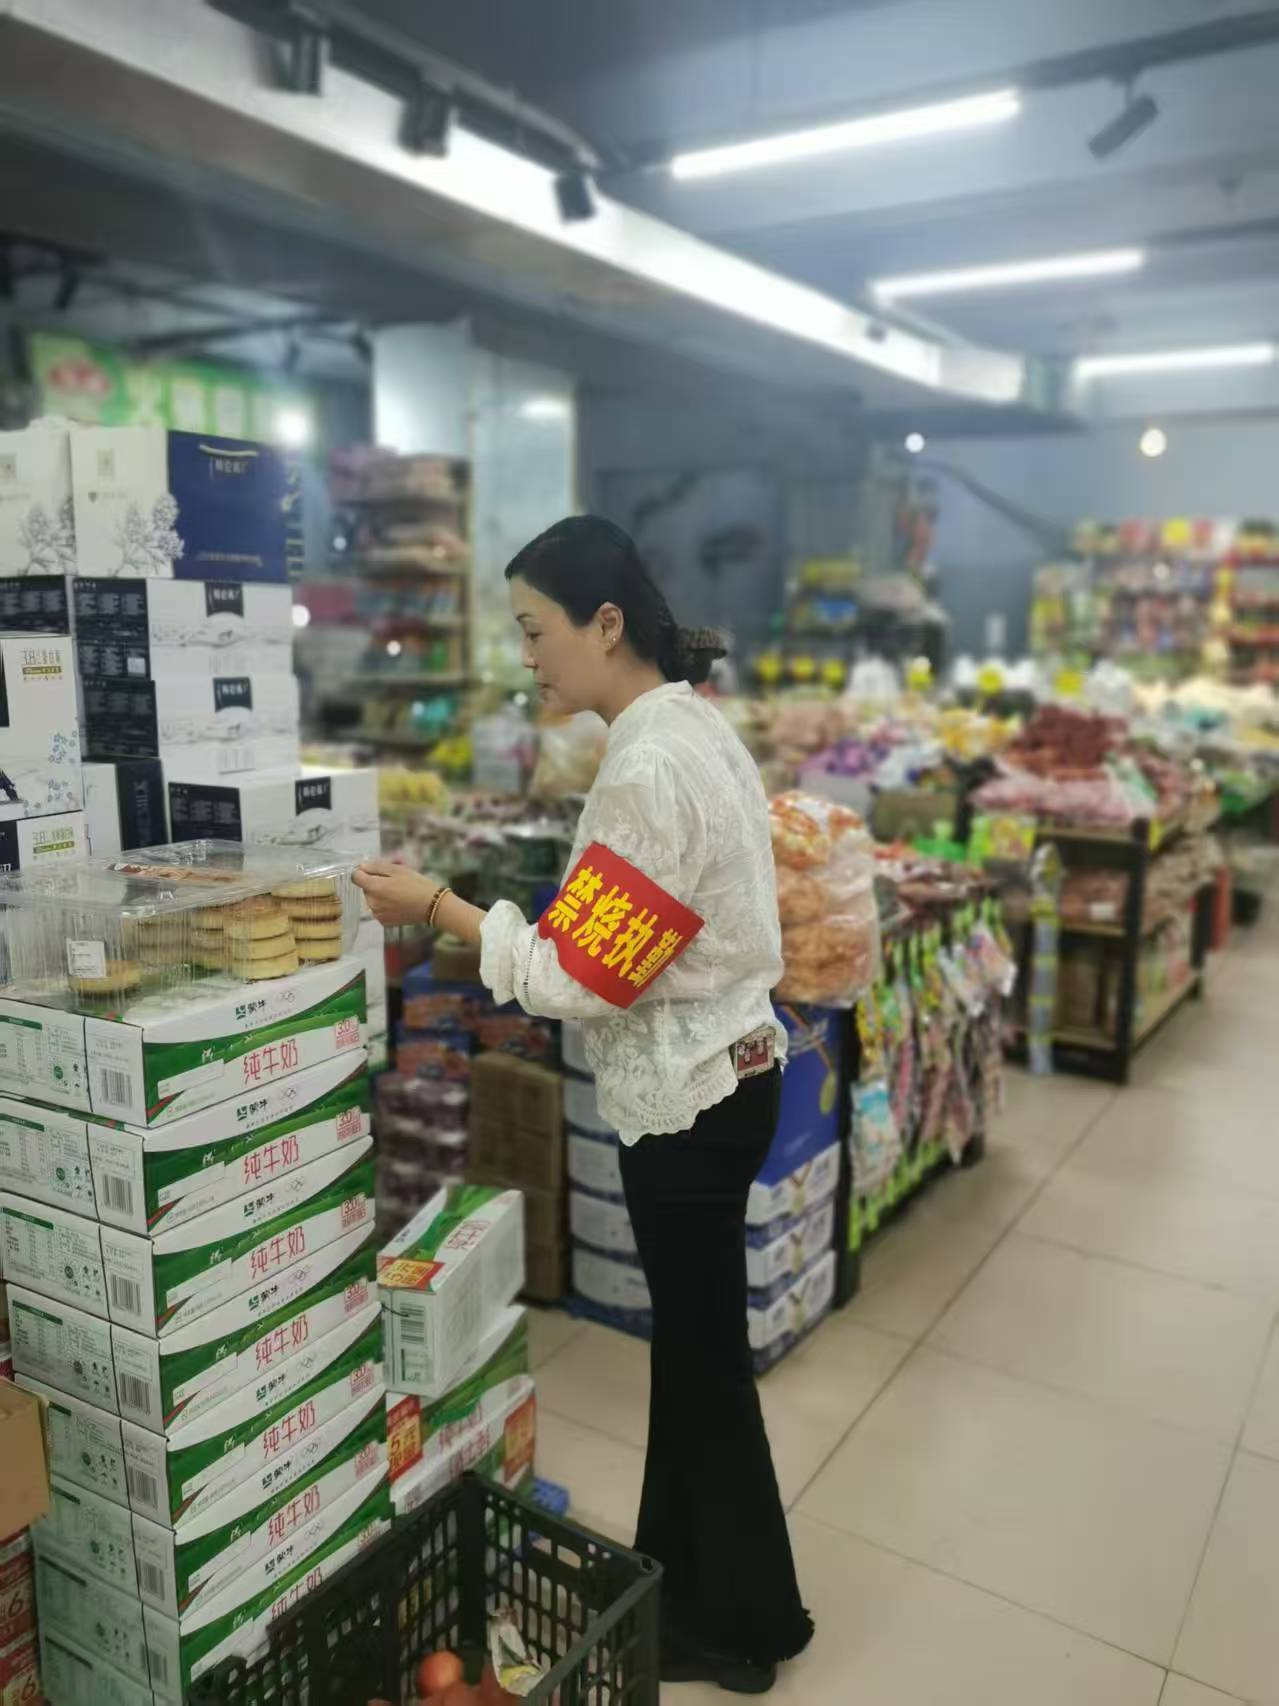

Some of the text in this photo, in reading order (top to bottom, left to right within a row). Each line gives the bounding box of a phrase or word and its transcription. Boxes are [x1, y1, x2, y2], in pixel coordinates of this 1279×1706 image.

[547, 865, 683, 988] 禁烧执勤
[243, 1038, 299, 1085] 纯牛奶
[244, 1135, 299, 1184] 纯牛奶
[250, 1225, 305, 1279] 纯牛奶
[256, 1314, 308, 1371] 纯牛奶
[264, 1400, 316, 1459] 纯牛奶
[268, 1485, 321, 1546] 纯牛奶
